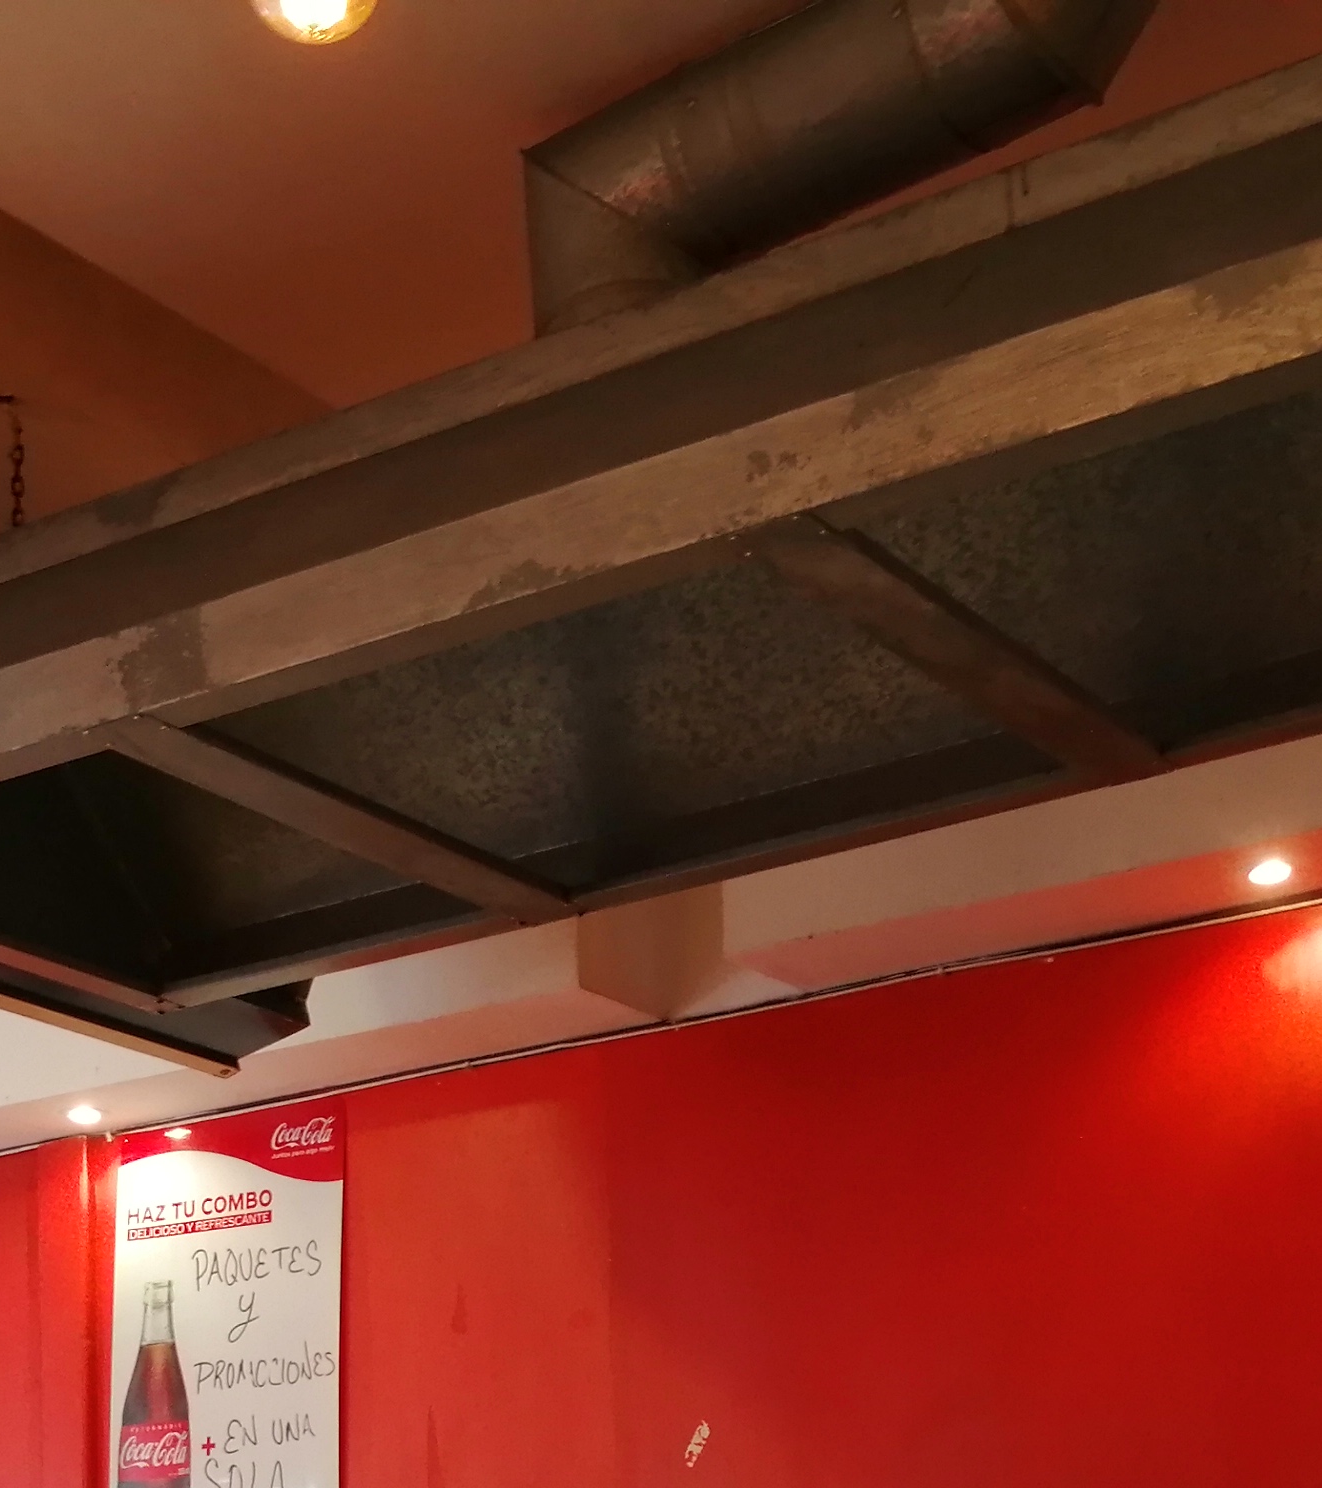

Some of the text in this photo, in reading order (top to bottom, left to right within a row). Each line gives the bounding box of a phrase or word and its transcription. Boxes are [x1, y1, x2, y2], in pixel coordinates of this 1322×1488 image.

[271, 1115, 336, 1150] Coca-Cola
[127, 1189, 273, 1225] HAZ TU COMBO
[128, 1211, 270, 1240] DELICIOSO Y REFRESCANTE
[191, 1239, 322, 1291] PAQUETES
[120, 1431, 188, 1469] Coca-Cola
[223, 1413, 316, 1454] EN UNA
